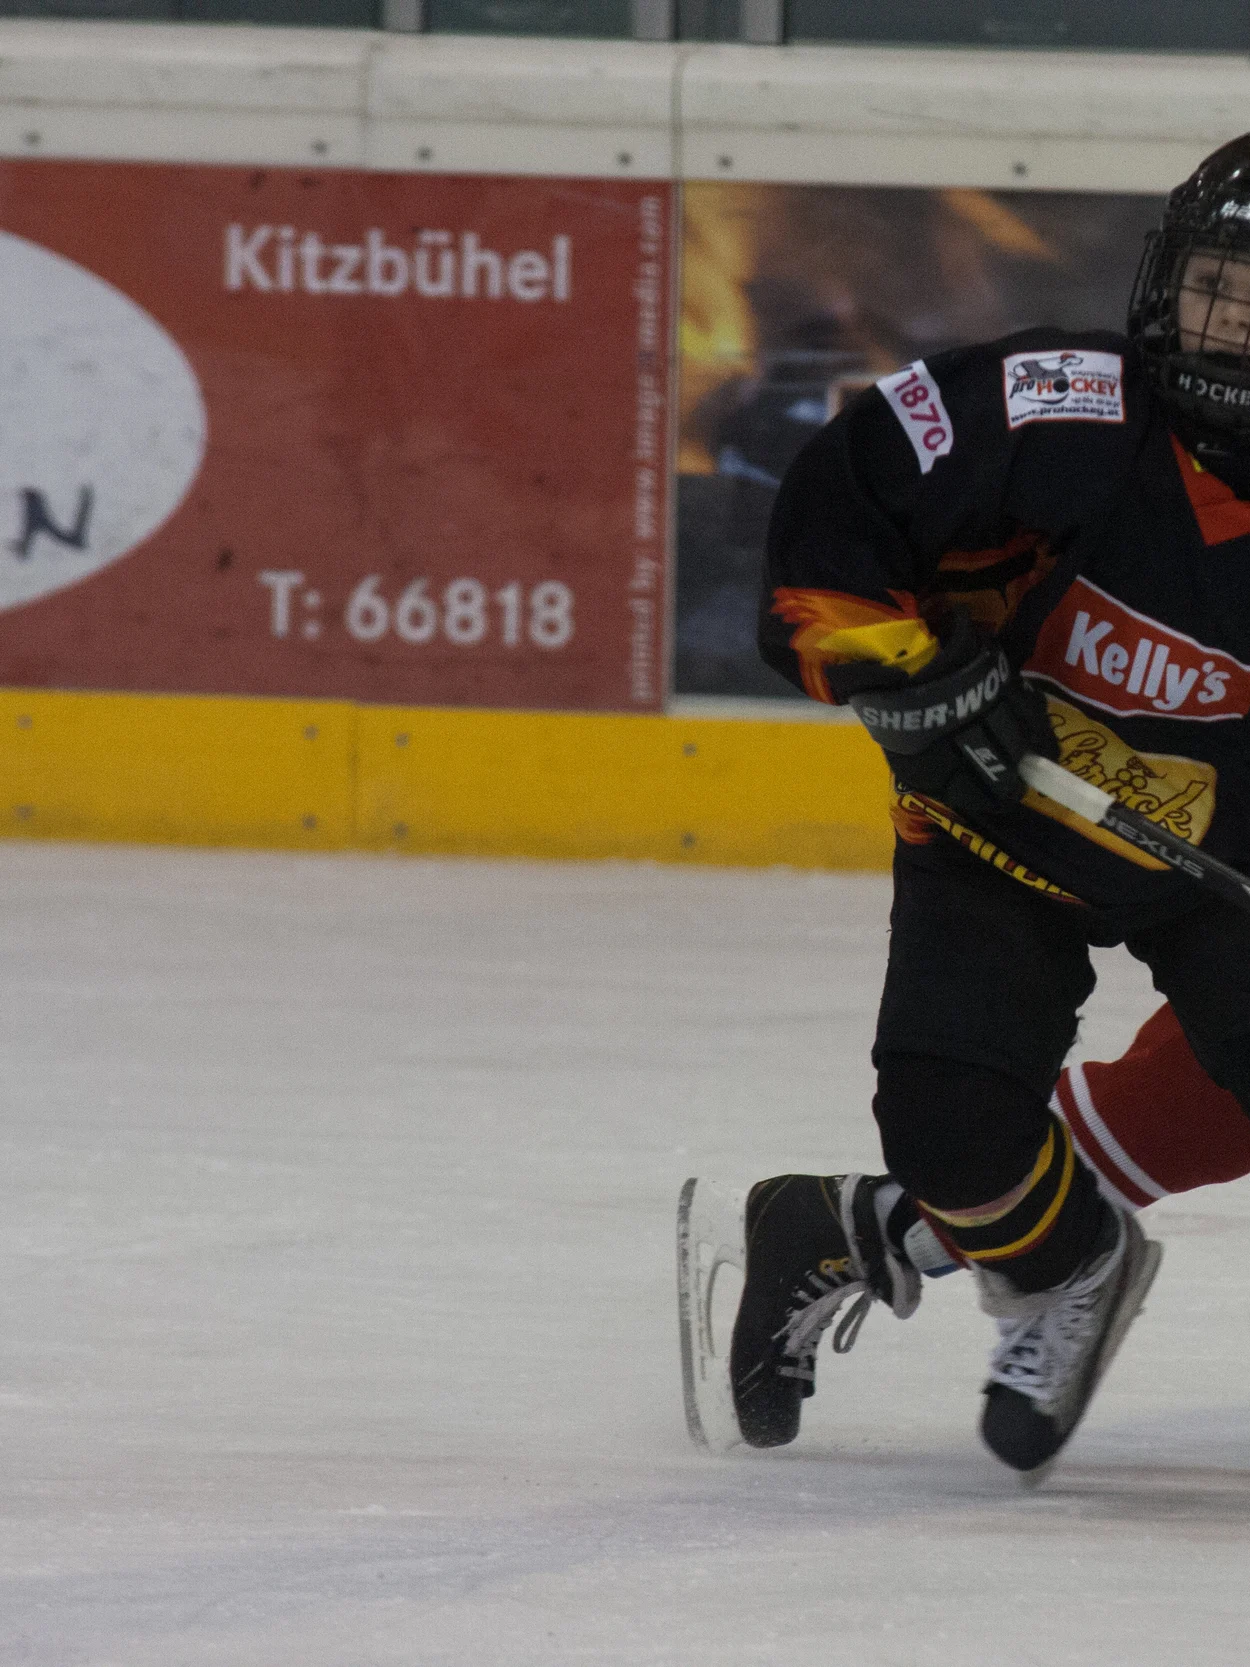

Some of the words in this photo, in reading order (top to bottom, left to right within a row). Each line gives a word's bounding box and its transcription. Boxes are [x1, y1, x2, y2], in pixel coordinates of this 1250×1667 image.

[223, 222, 572, 301] Kitzbühel
[893, 372, 948, 452] 1870
[259, 570, 320, 638] T:
[345, 575, 576, 648] 66818
[1065, 611, 1232, 711] Kelly's
